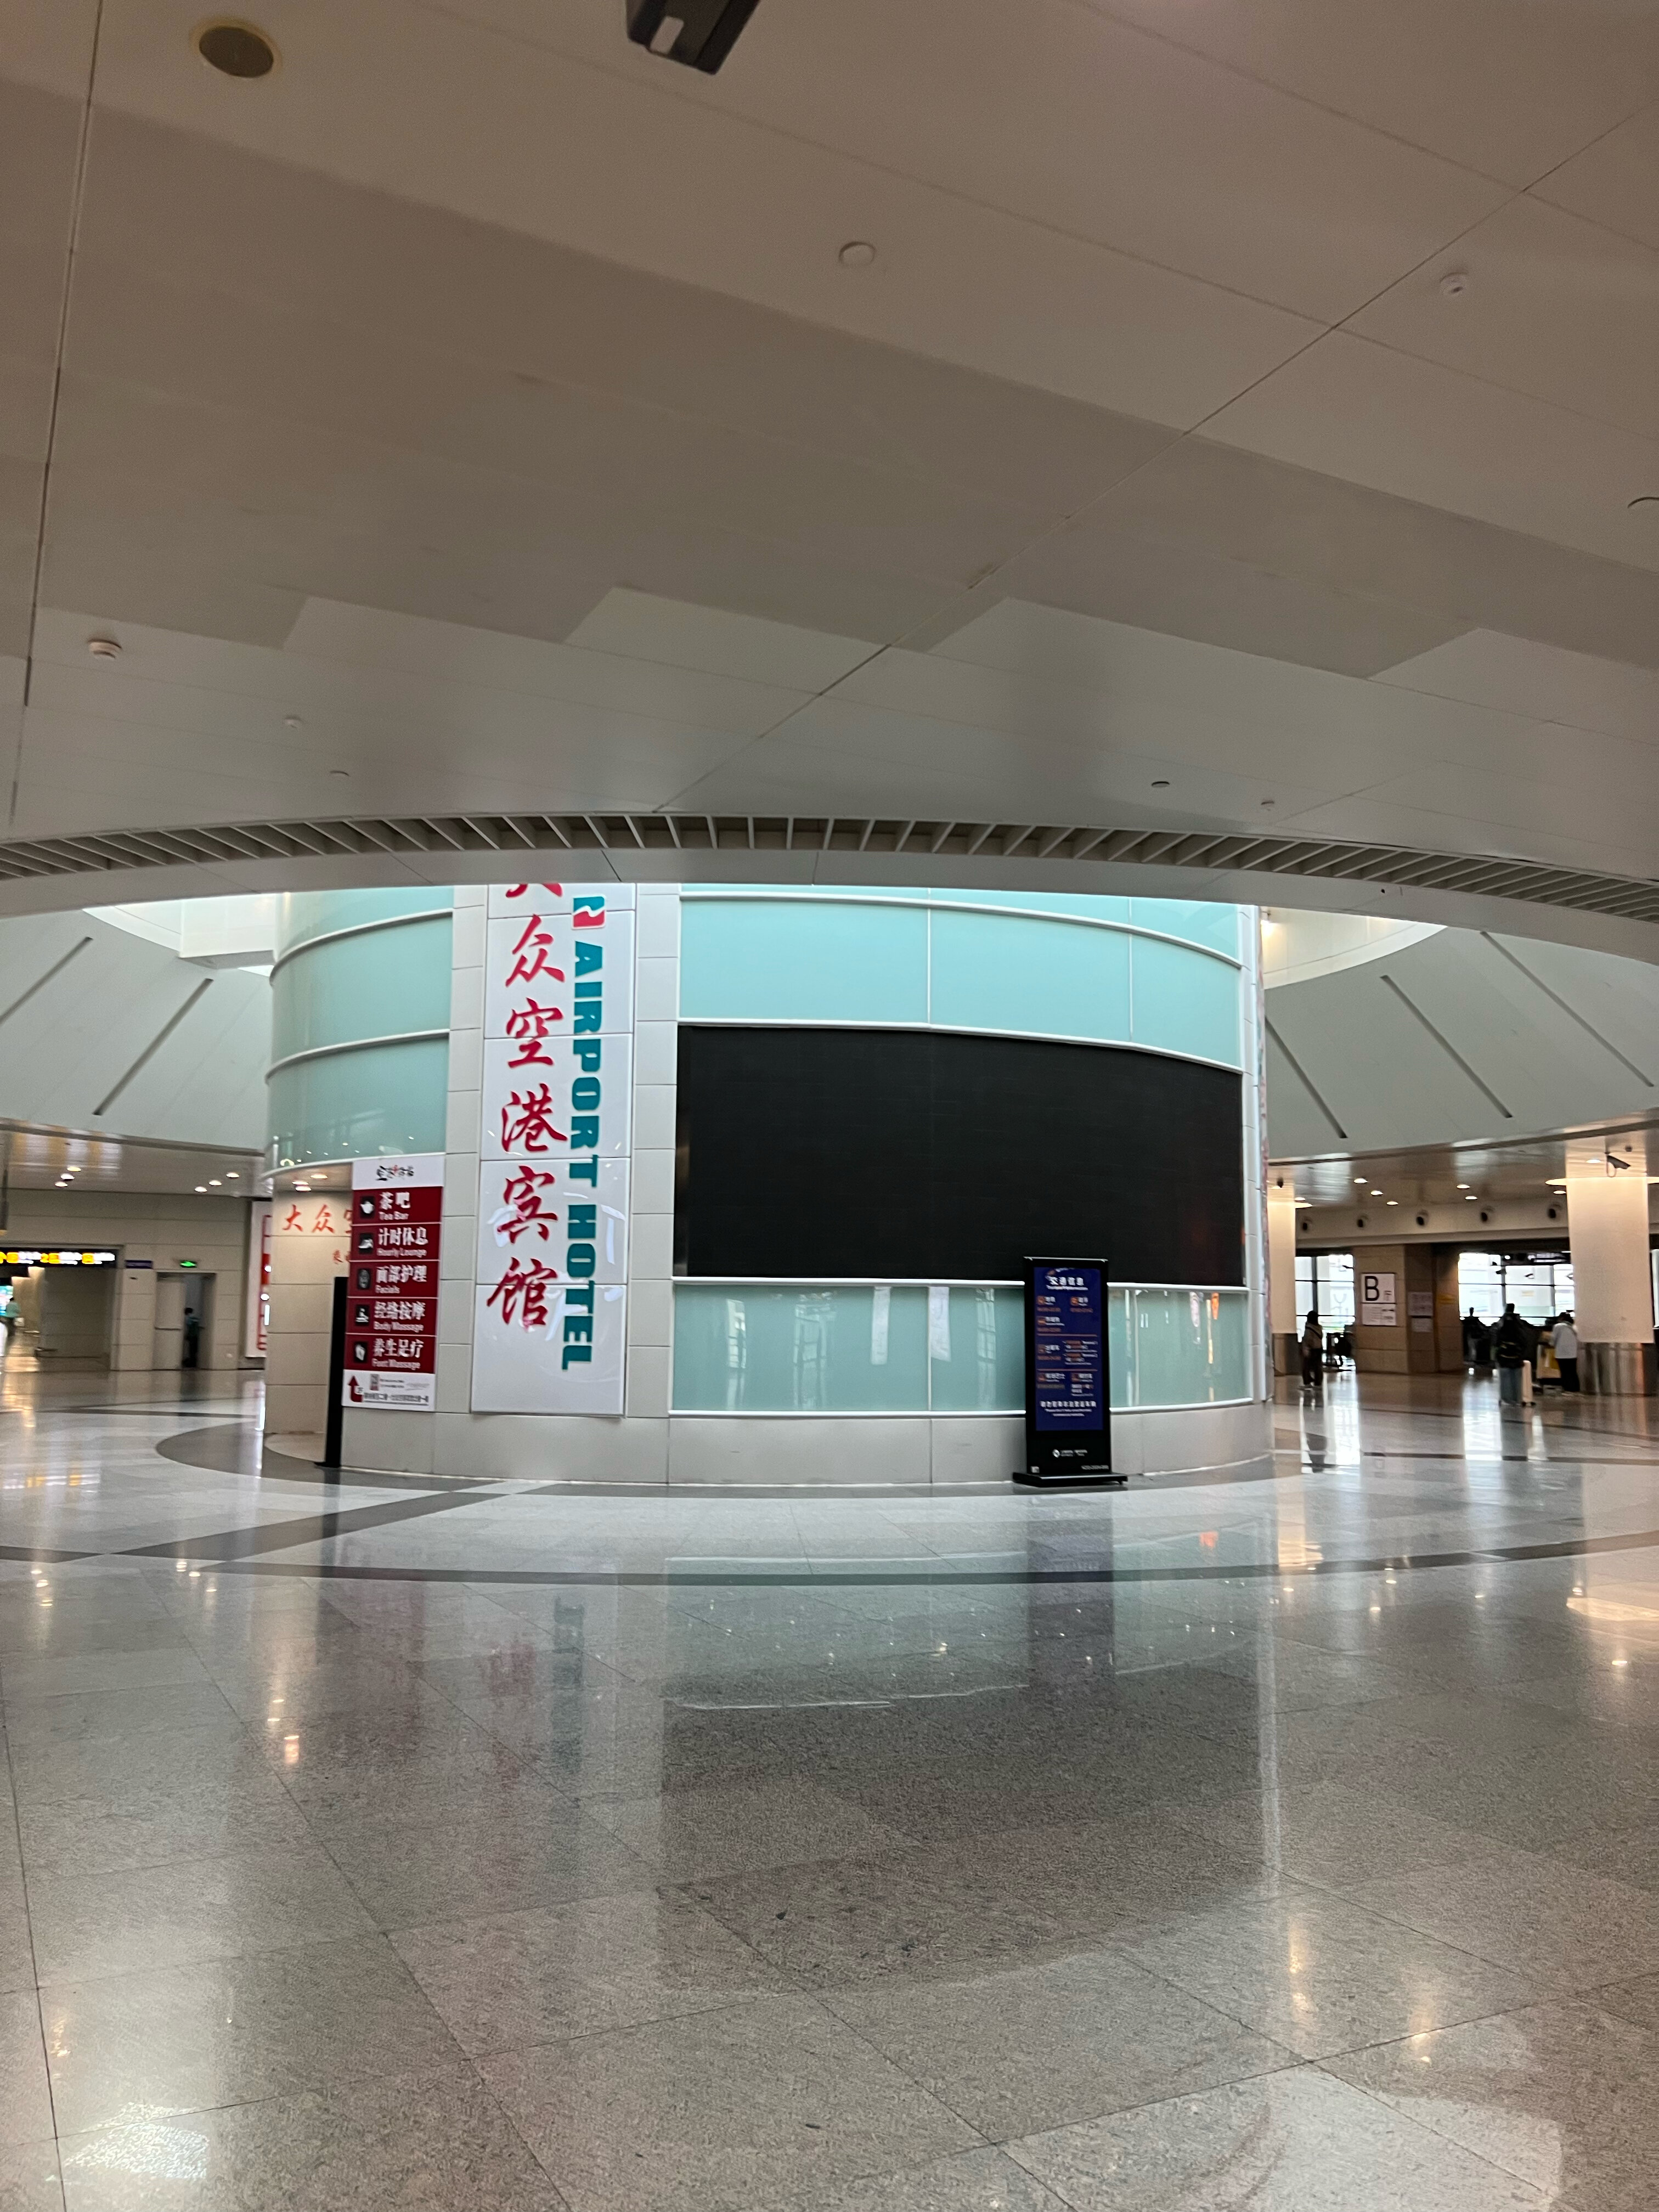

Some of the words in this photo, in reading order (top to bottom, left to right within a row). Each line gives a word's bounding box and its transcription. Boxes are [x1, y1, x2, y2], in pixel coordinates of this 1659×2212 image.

[568, 940, 603, 1188] AIRPORT
[379, 1192, 411, 1210] 茶吧
[379, 1211, 393, 1221] Tea
[394, 1211, 409, 1220] Bar
[378, 1226, 429, 1246] 计时休息
[376, 1248, 399, 1258] Hourly
[399, 1248, 427, 1258] Lounge
[376, 1264, 427, 1284] 面部护理
[561, 1204, 597, 1371] HOTEL
[1365, 1276, 1380, 1301] B
[374, 1301, 426, 1320] 经络按摩
[373, 1321, 392, 1332] Body
[391, 1321, 425, 1333] Massage
[373, 1338, 425, 1358] 养生足疗
[371, 1358, 389, 1367] Foot
[388, 1358, 421, 1370] Massage
